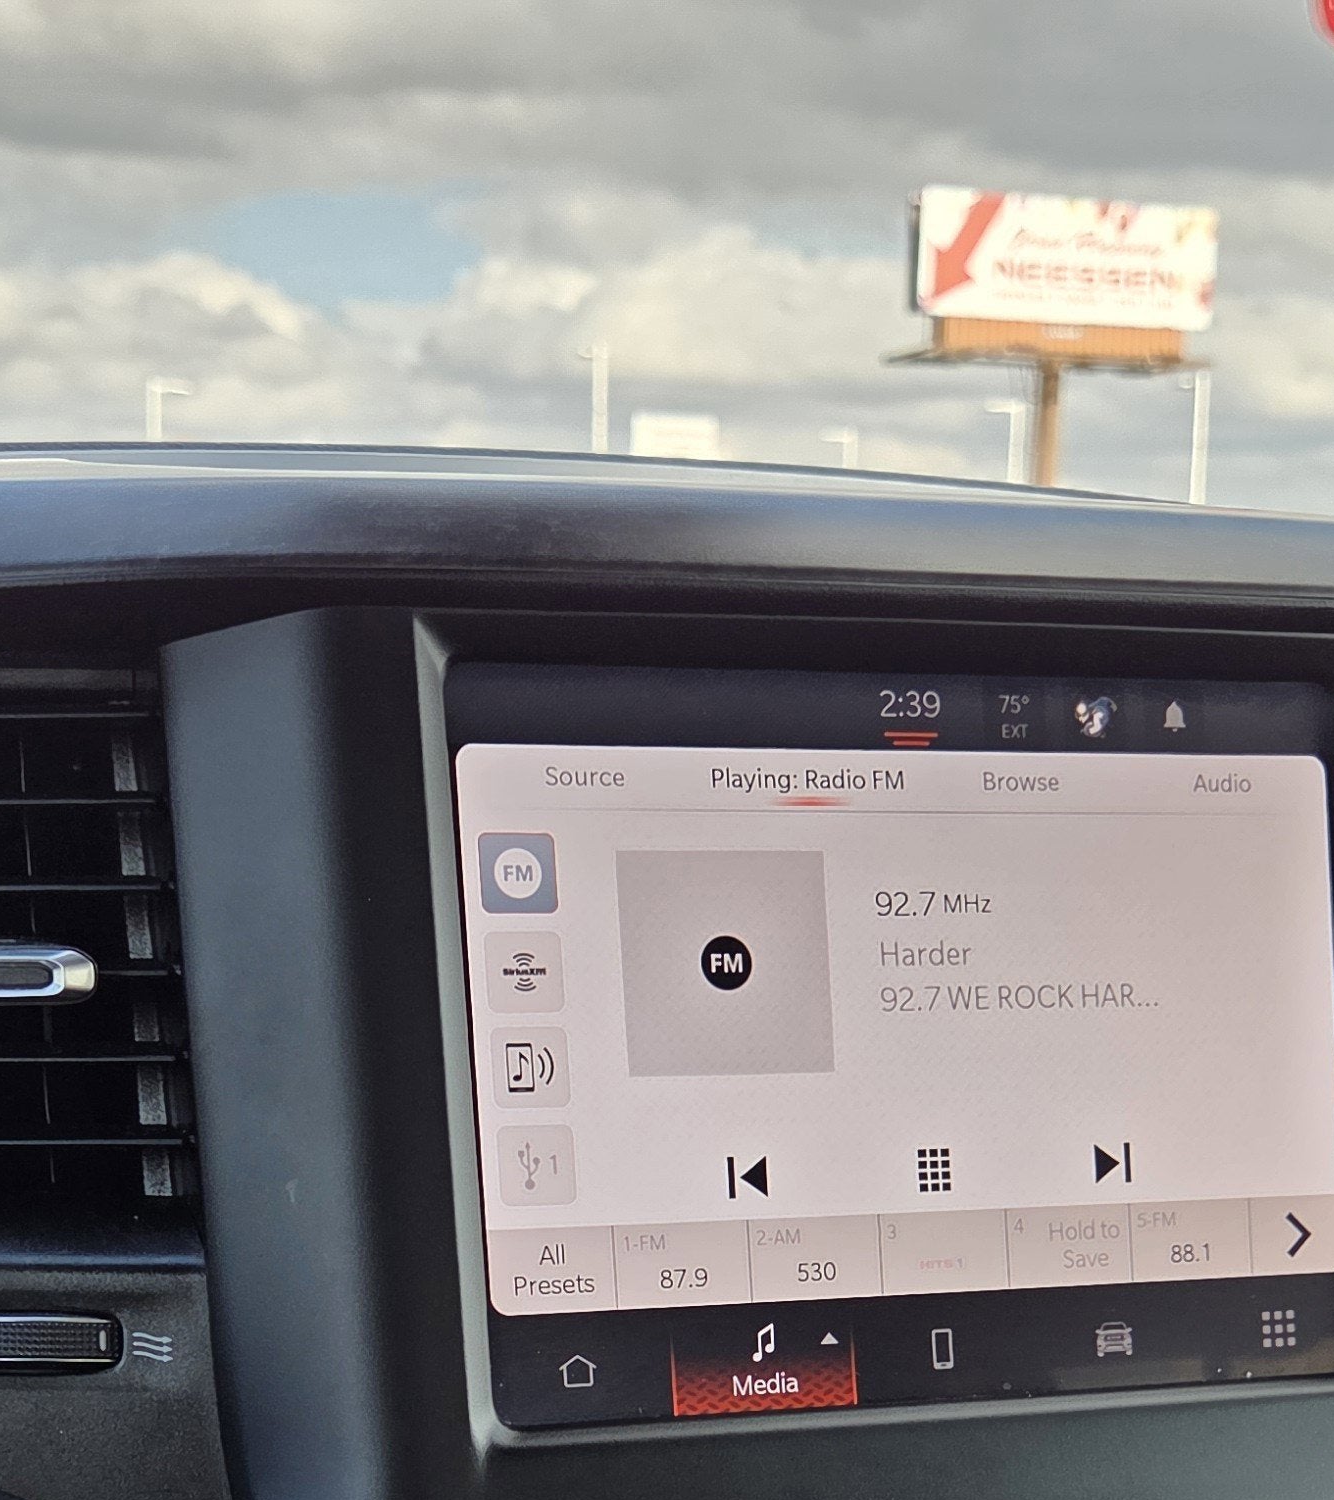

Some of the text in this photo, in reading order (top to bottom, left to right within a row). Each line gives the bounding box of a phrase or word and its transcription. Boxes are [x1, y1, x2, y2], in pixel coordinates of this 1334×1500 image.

[880, 690, 941, 719] 2:39
[999, 694, 1030, 714] 75°
[1002, 723, 1028, 739] EXT
[545, 766, 625, 788] Source
[711, 768, 905, 793] Playing: Radio FM
[983, 771, 1059, 792] Browse
[1193, 773, 1252, 793] Audio
[503, 865, 533, 881] FM
[875, 892, 991, 917] 92.7 MHz
[710, 953, 744, 974] FM
[880, 941, 972, 967] Harder
[880, 986, 941, 1012] 92.7
[948, 986, 990, 1010] WE
[998, 985, 1074, 1009] ROCK
[548, 1155, 559, 1175] 1
[1014, 1218, 1024, 1234] 4
[1049, 1219, 1120, 1242] Hold to
[1137, 1211, 1176, 1229] 5-FM
[756, 1228, 801, 1246] 2-AM
[887, 1224, 897, 1239] 3
[624, 1234, 666, 1252] 1-FM
[1170, 1243, 1212, 1264] 88.1
[539, 1244, 565, 1264] All
[1063, 1249, 1109, 1269] Save
[659, 1268, 708, 1290] 87.9
[797, 1262, 837, 1283] 530
[513, 1275, 595, 1296] Presets
[732, 1373, 799, 1396] Media
